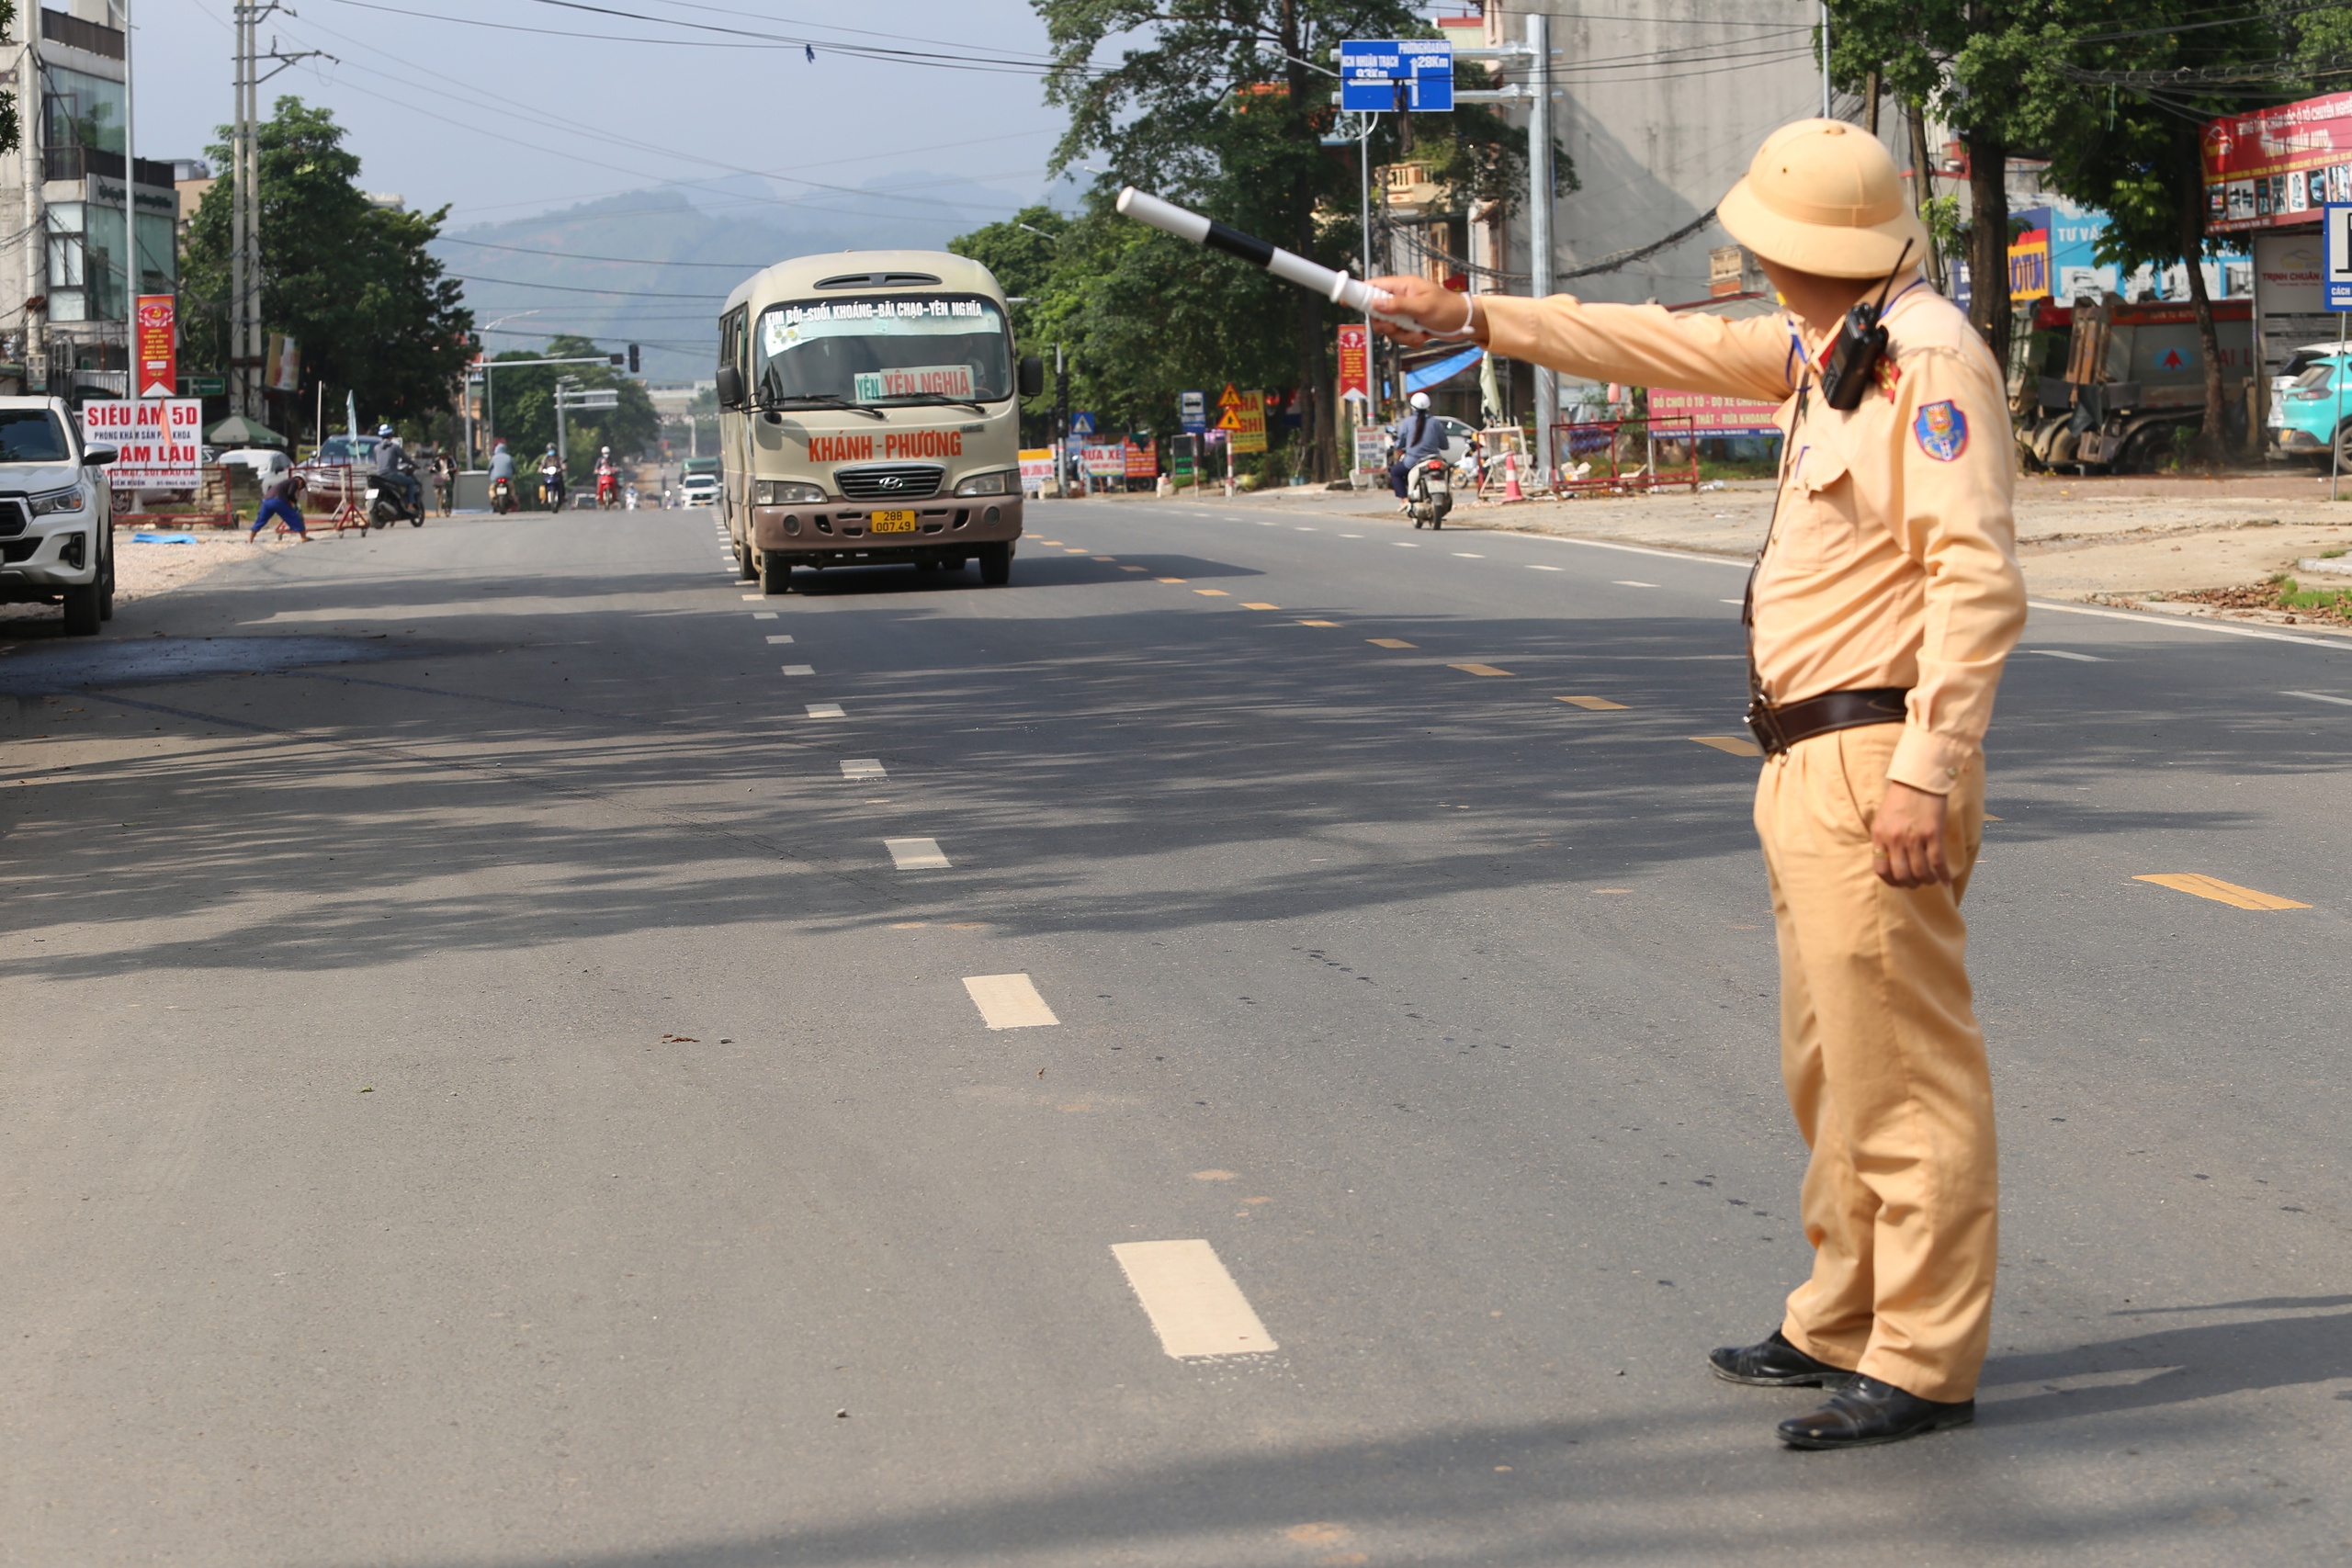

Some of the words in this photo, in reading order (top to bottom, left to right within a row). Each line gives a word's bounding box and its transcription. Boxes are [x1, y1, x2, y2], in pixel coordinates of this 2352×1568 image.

[1418, 56, 1449, 68] 28Km
[2058, 225, 2077, 243] TƯ
[2080, 222, 2104, 242] VẤ
[2331, 285, 2351, 296] CÁCH
[765, 310, 785, 327] KIM
[884, 369, 916, 398] YÊN
[87, 404, 130, 426] SIÊU
[173, 407, 198, 425] 5D
[173, 431, 191, 439] KHOA
[112, 443, 151, 462] ÁM
[158, 442, 196, 466] LẬU
[808, 430, 873, 462] KHÁNH
[885, 429, 962, 458] PHƯƠNG
[884, 511, 902, 521] 28B
[876, 521, 910, 531] 007.49
